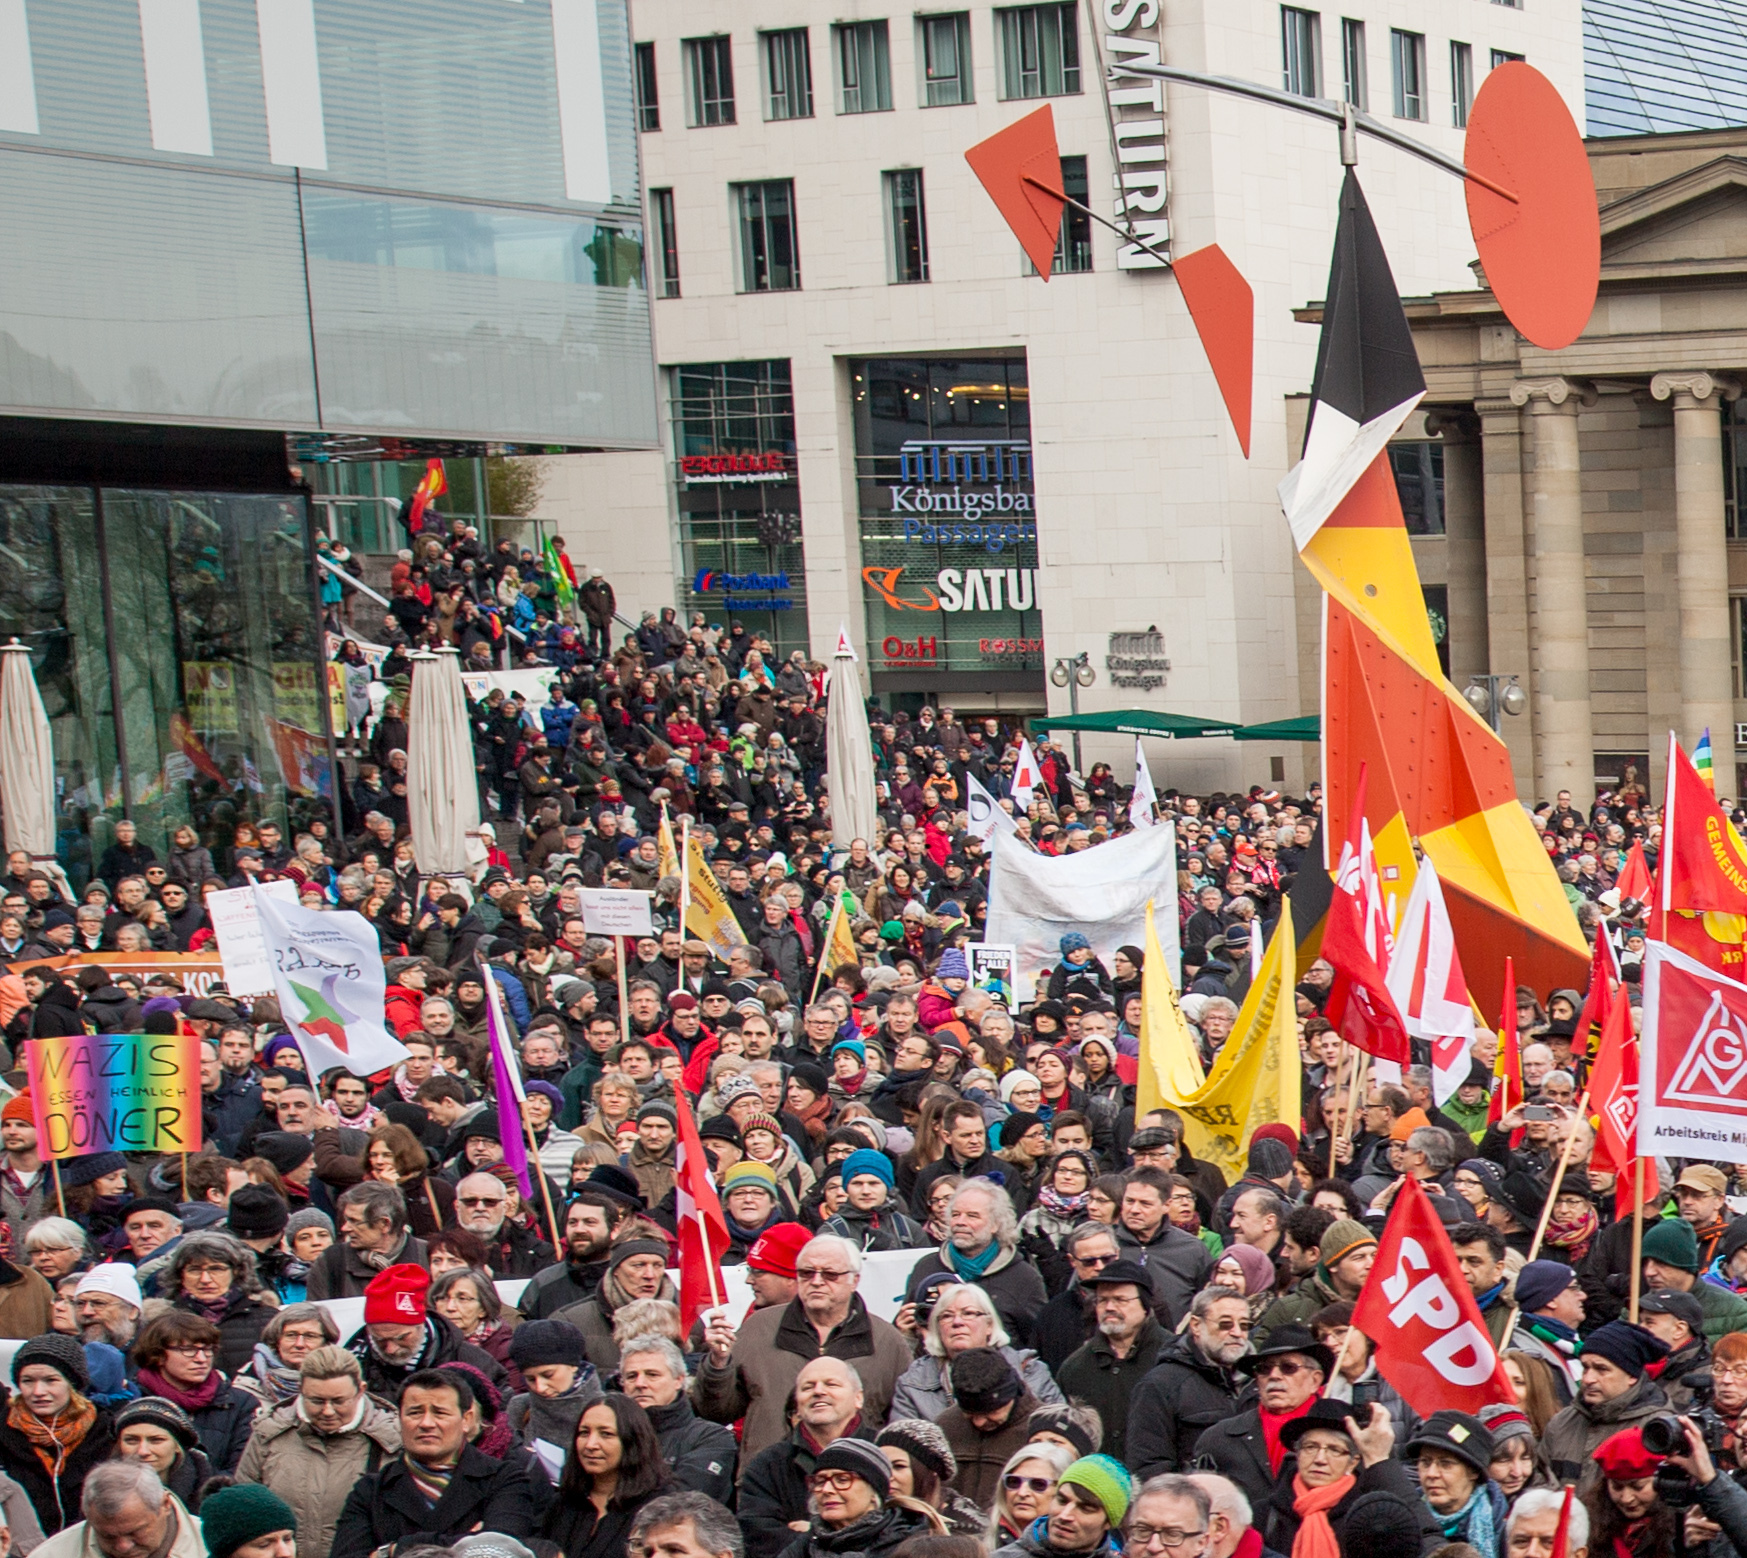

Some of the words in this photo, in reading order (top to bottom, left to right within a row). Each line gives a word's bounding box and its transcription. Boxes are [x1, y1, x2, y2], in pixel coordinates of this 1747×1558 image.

[1103, 0, 1172, 270] SATURN
[937, 568, 1042, 612] SATU
[39, 1043, 180, 1082] NAZIS
[49, 1088, 97, 1106] ESSEN
[110, 1086, 188, 1098] HEIMLICH
[44, 1104, 184, 1154] DÖNER
[1653, 1125, 1728, 1145] Arbeitskreis
[1380, 1236, 1497, 1387] SPD
